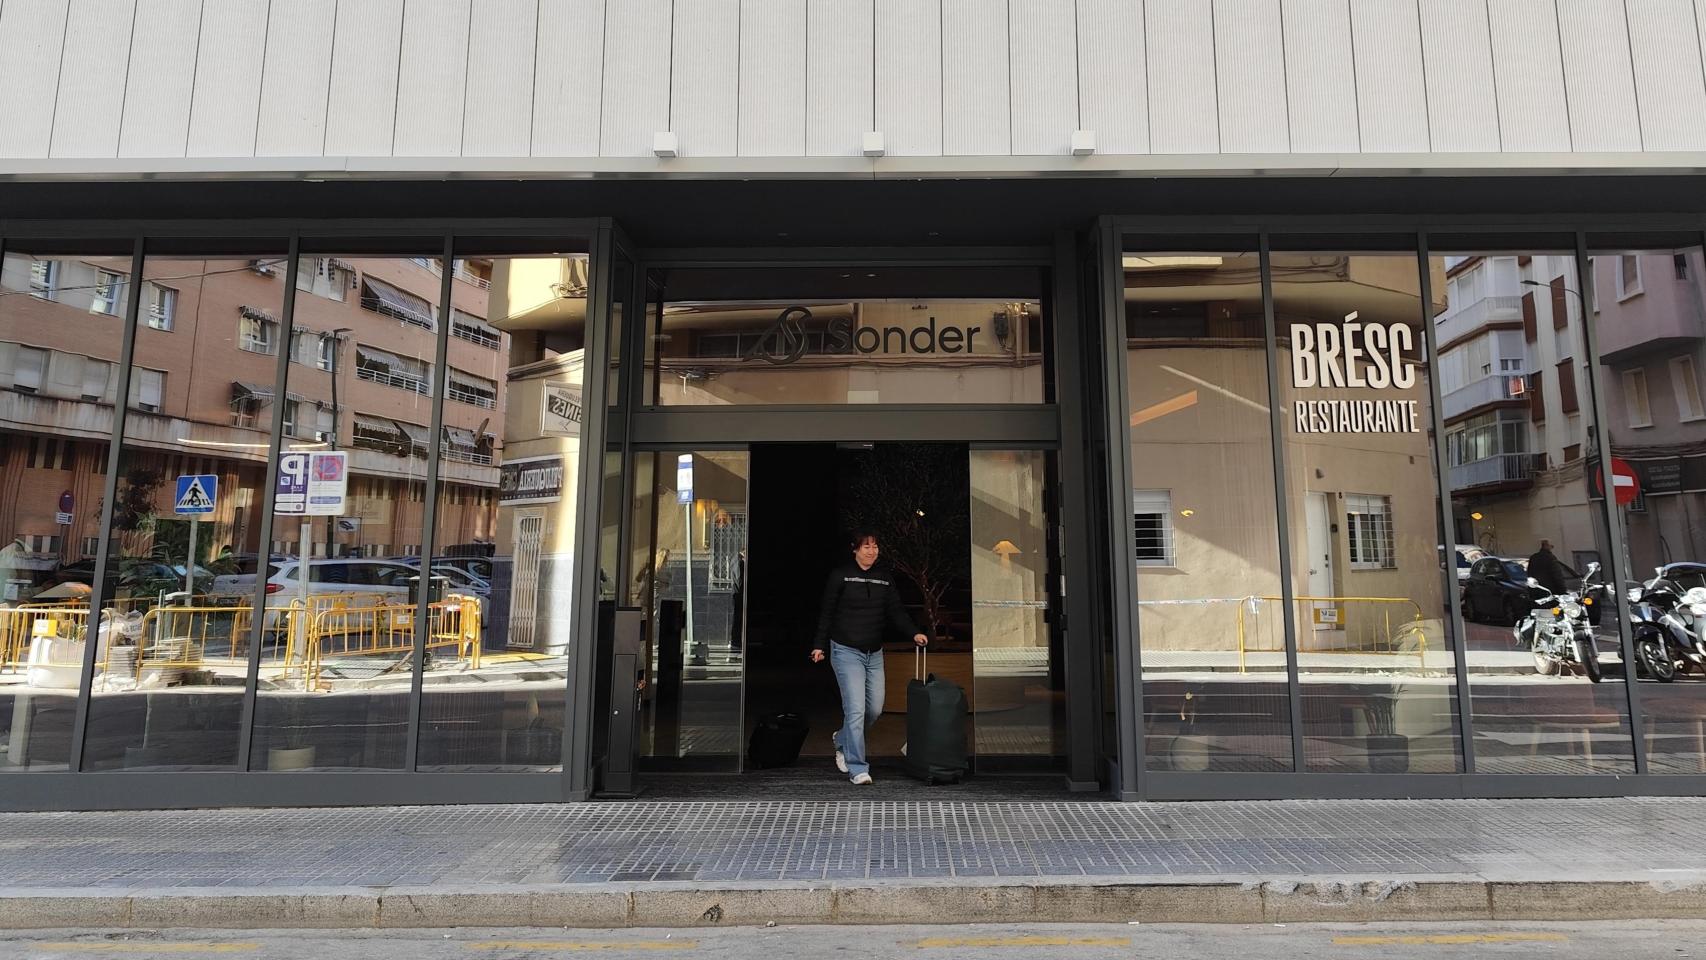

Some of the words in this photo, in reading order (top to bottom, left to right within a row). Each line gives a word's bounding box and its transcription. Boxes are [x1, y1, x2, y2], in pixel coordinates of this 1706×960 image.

[828, 316, 981, 354] Sonder
[1290, 310, 1416, 389] BRÉSC
[1295, 400, 1421, 434] RESTAURANTE
